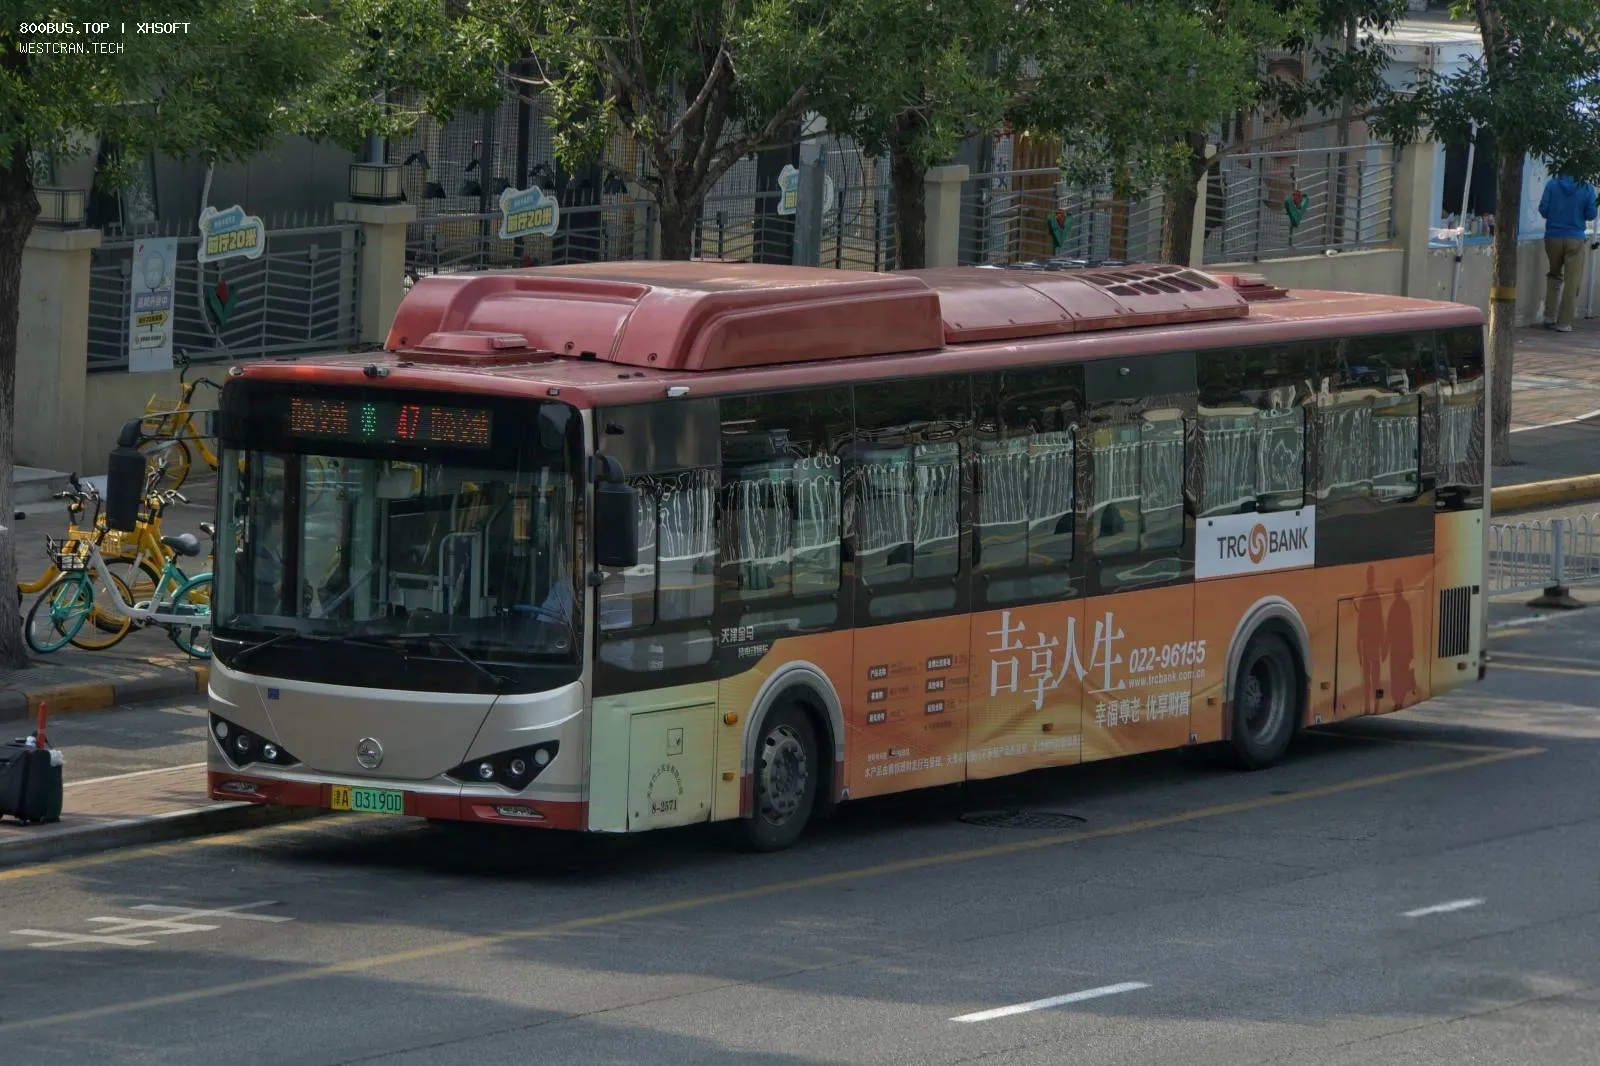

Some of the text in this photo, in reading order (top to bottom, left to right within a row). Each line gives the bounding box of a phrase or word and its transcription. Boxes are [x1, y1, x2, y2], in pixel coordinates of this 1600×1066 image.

[396, 404, 421, 439] 47
[1217, 526, 1309, 560] TRC BANK
[986, 611, 1126, 712] 吉享人生
[1129, 640, 1207, 673] 022-96155
[1128, 669, 1206, 688] www.trcbank.com.cn
[1095, 691, 1191, 728] 幸福尊老 优享财富
[355, 791, 402, 811] 03190D
